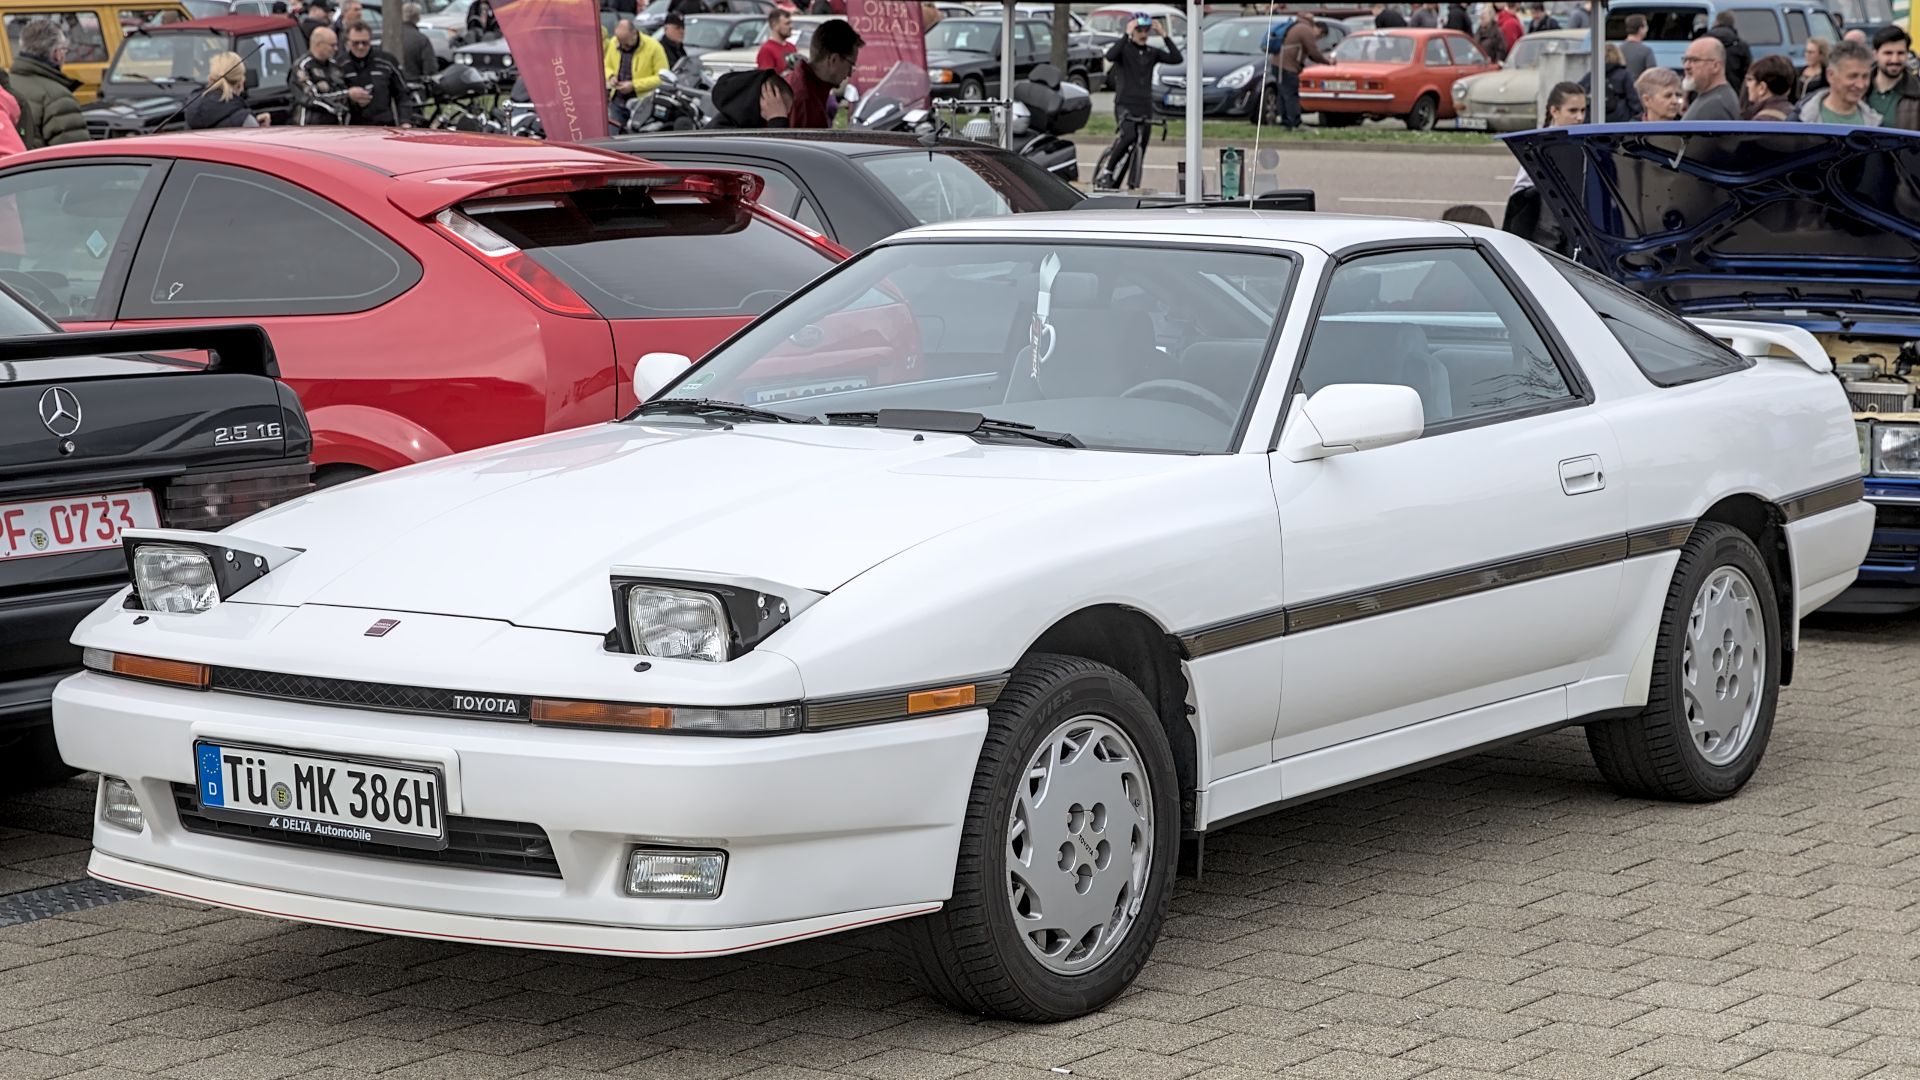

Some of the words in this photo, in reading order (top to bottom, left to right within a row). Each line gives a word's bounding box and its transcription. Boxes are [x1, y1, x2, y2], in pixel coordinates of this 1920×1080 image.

[214, 425, 248, 442] 2.5
[256, 422, 281, 437] 16
[0, 509, 26, 551] F
[50, 499, 135, 544] 0733
[454, 695, 517, 713] TOYOTA
[208, 781, 218, 796] D
[224, 754, 268, 806] TÜ
[294, 763, 340, 816] MK
[347, 770, 437, 829] 386H
[283, 817, 311, 833] DELTA
[314, 822, 372, 841] Automobile
[1077, 834, 1094, 857] TOYOTA
